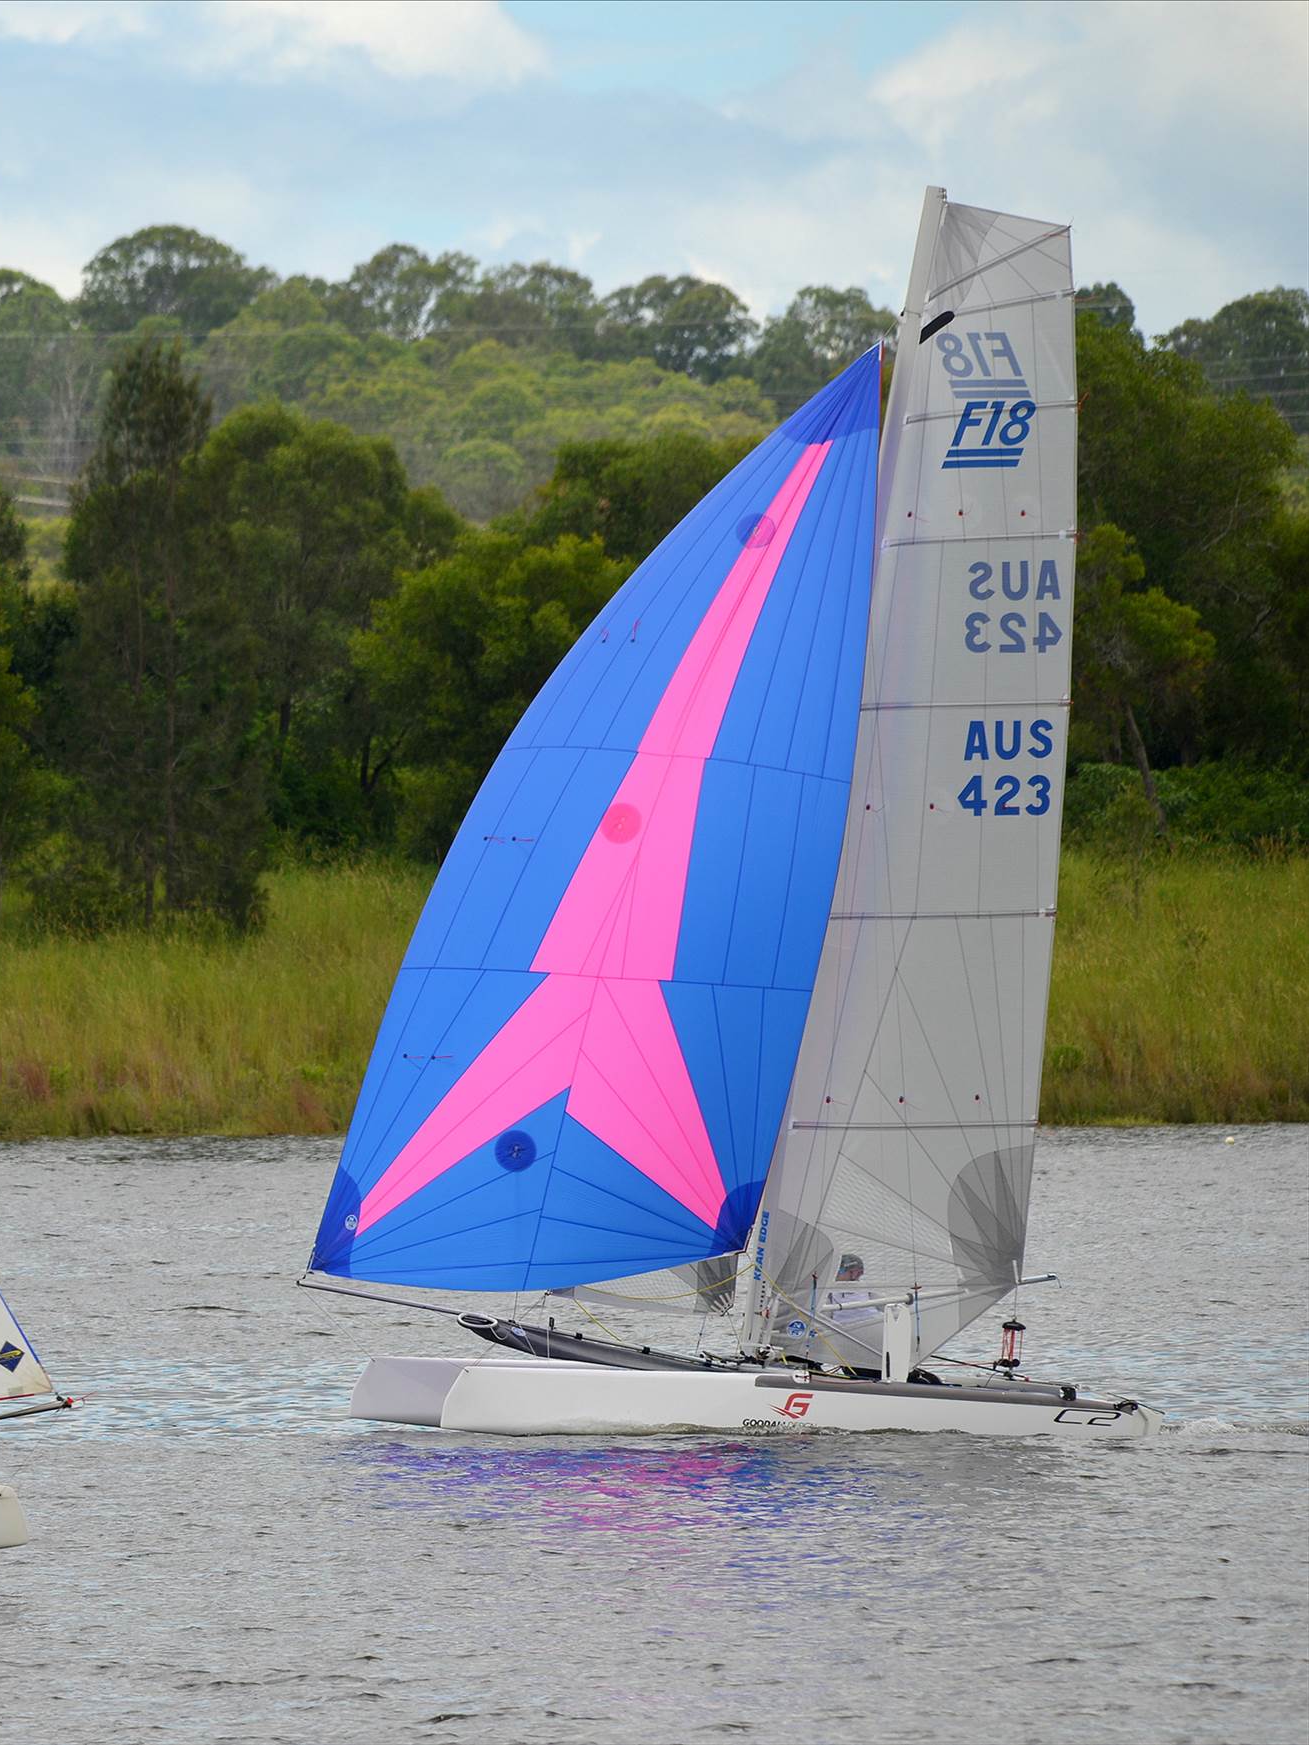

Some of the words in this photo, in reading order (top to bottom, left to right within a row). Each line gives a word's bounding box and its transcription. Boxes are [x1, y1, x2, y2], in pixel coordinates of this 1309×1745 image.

[951, 400, 1036, 446] F18
[964, 719, 1053, 761] AUS
[957, 775, 1051, 816] 423
